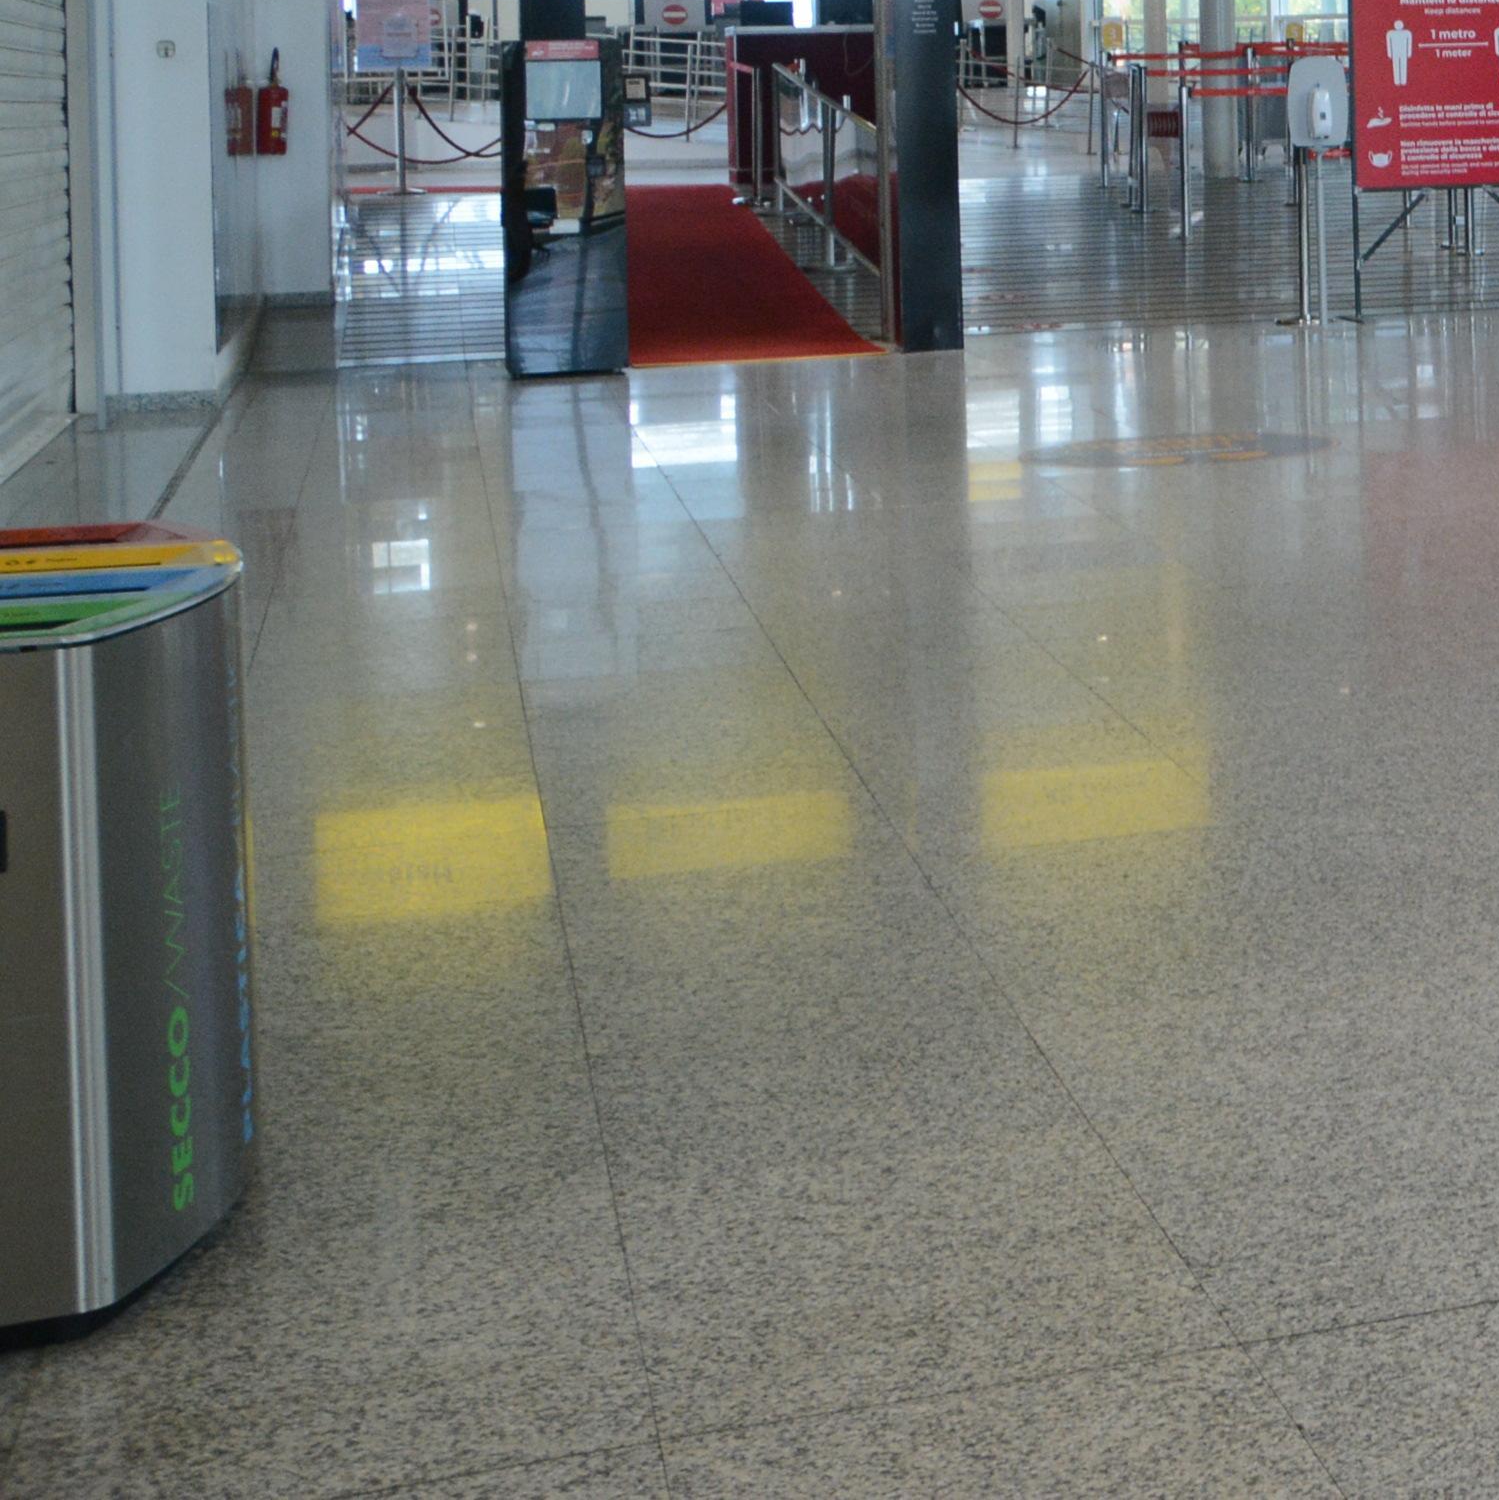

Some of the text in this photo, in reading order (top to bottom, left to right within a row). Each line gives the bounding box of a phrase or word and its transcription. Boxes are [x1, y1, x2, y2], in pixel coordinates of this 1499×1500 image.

[1424, 8, 1444, 16] Keep
[1430, 30, 1476, 40] 1 metro
[1435, 49, 1472, 58] 1 meter
